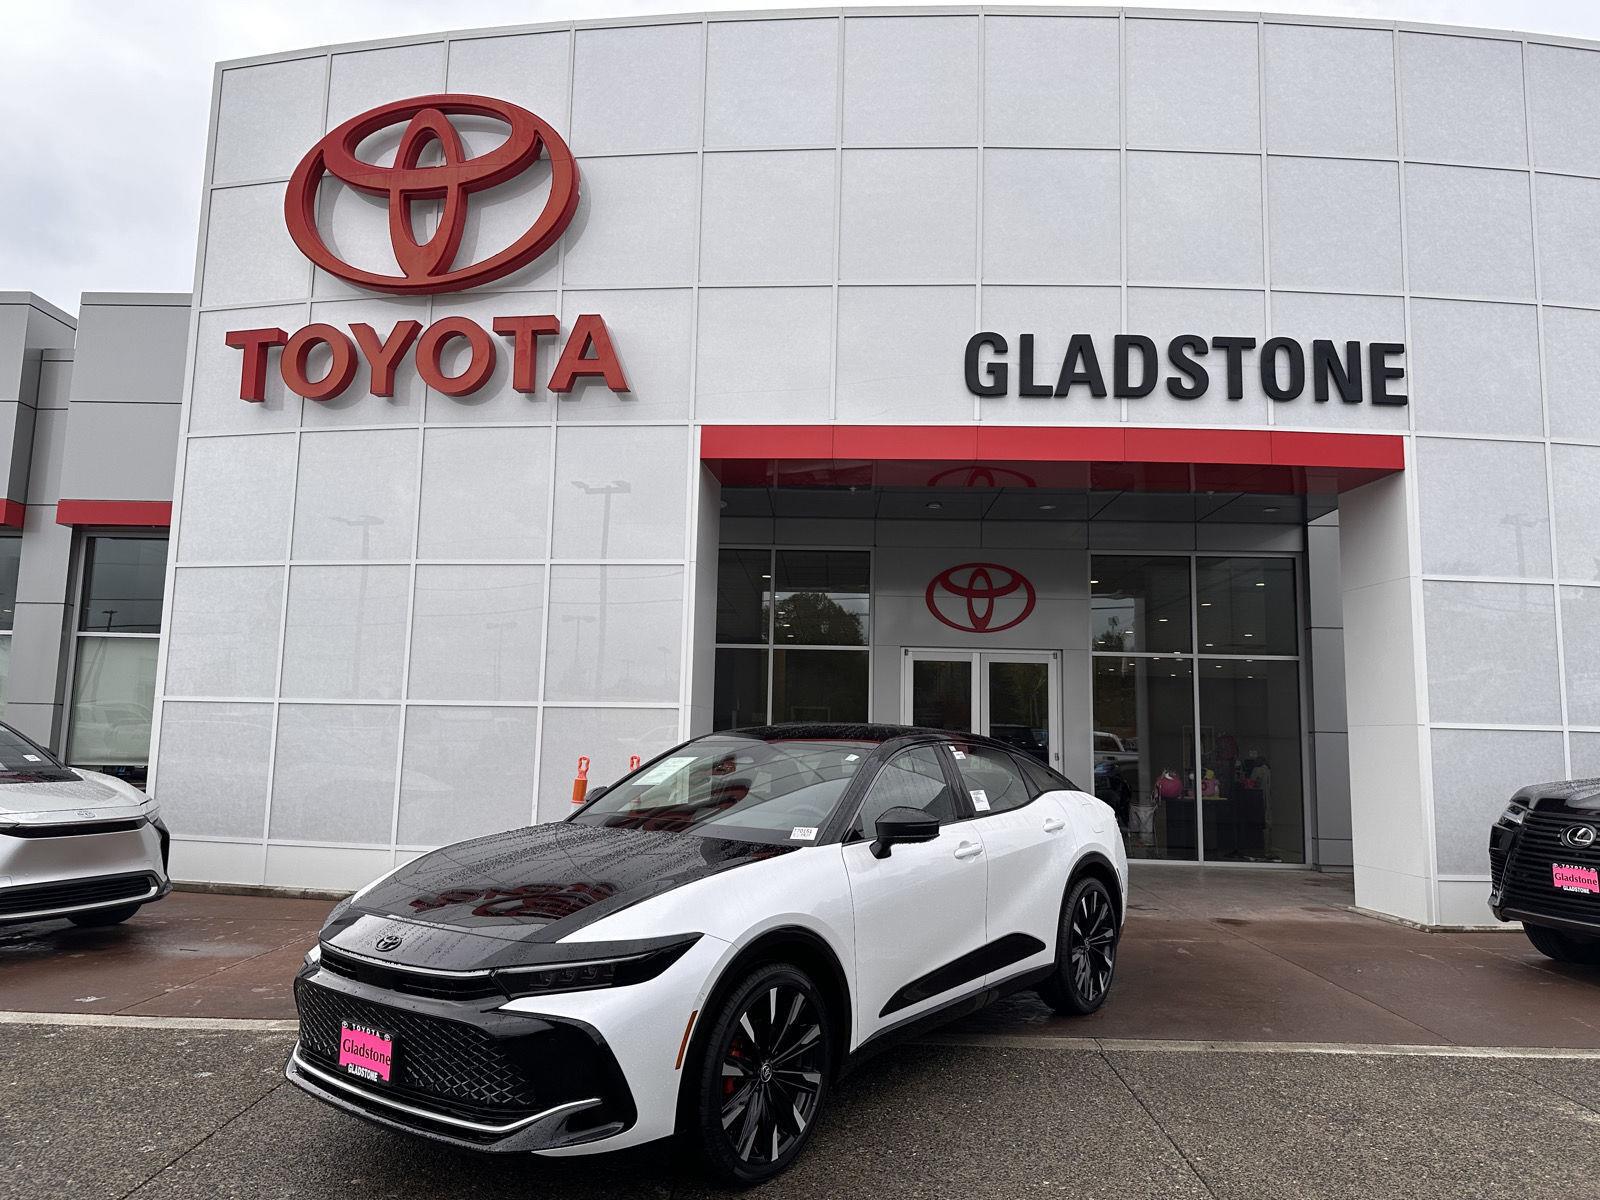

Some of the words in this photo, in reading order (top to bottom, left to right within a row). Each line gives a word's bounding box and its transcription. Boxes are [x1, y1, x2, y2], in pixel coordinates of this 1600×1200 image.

[226, 314, 631, 403] TOYOTA
[964, 331, 1408, 406] GLADSTONE
[1554, 872, 1598, 885] Gladstone
[1562, 885, 1590, 894] GLADSTONE
[352, 1023, 380, 1037] TOYOTA
[342, 1038, 391, 1066] Gladstone
[347, 1063, 378, 1082] GLADSTONE
